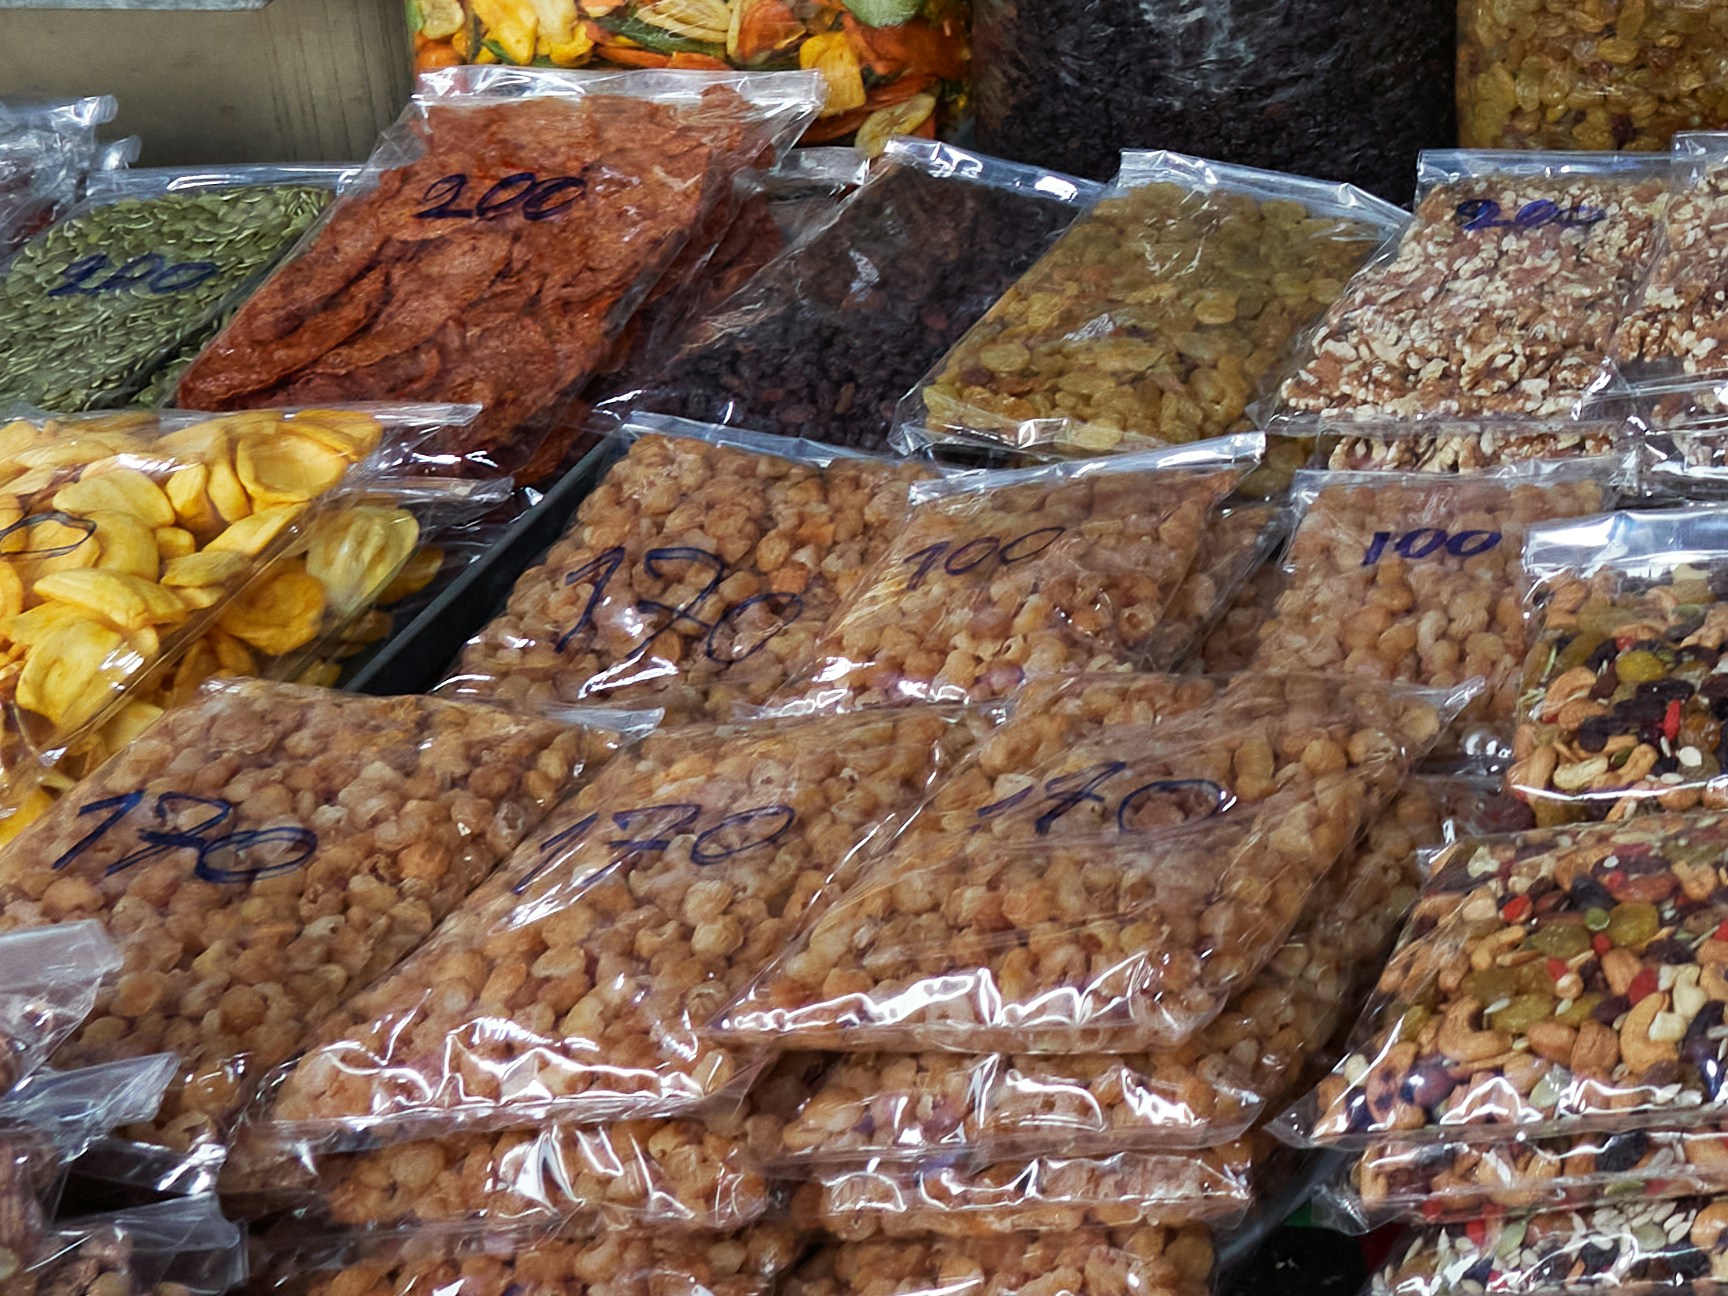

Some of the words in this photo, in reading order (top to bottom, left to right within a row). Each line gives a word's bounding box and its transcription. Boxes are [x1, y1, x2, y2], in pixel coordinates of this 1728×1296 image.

[413, 172, 589, 223] 200
[1454, 198, 1607, 232] 200
[905, 526, 1066, 591] 100
[1361, 527, 1505, 567] 100
